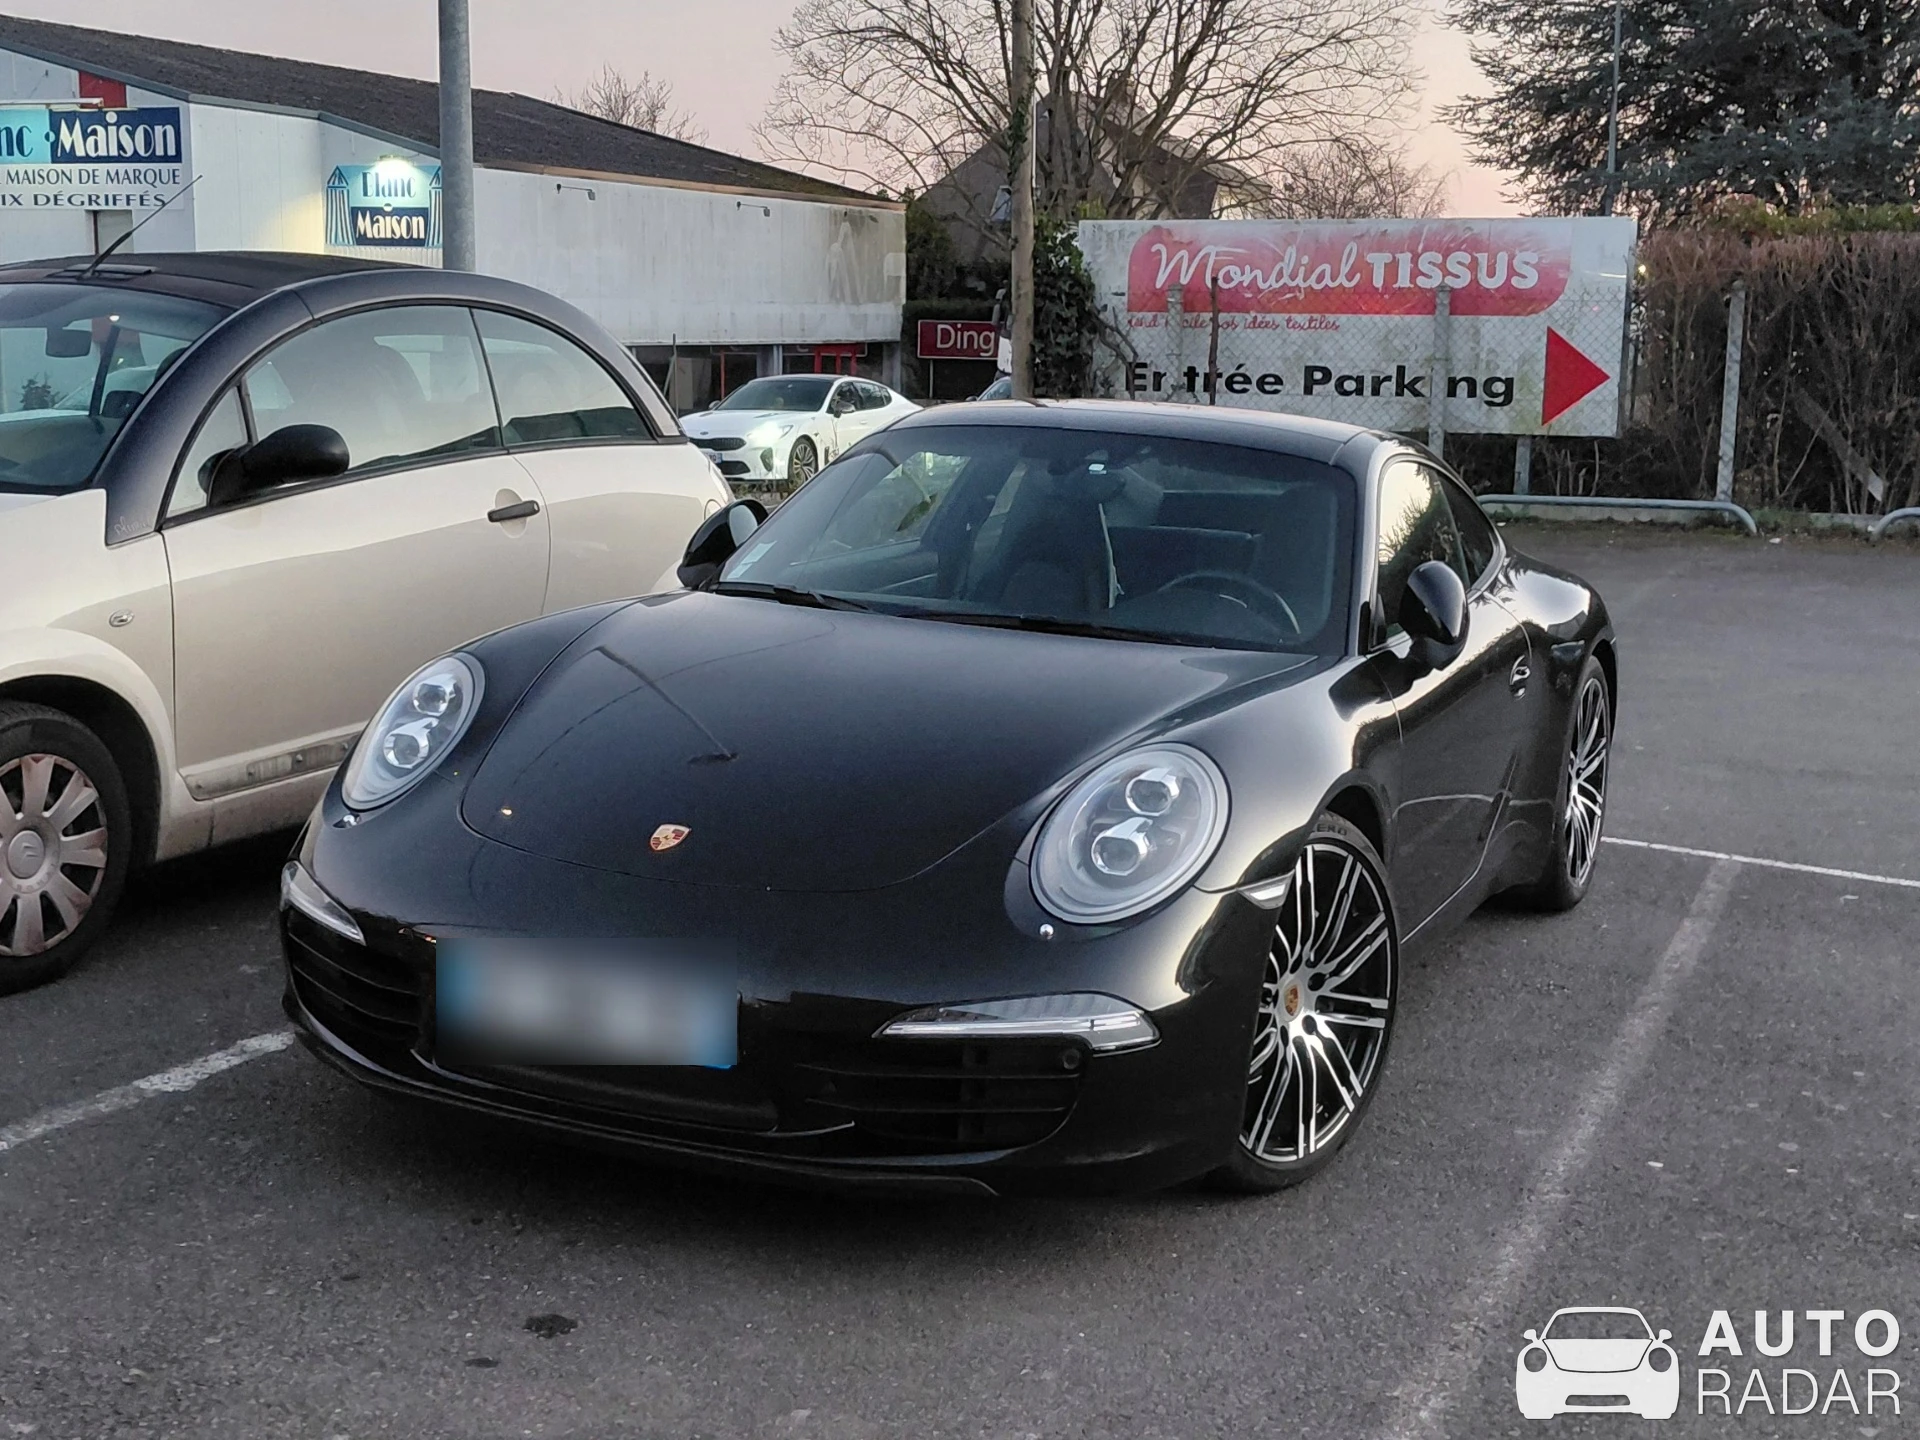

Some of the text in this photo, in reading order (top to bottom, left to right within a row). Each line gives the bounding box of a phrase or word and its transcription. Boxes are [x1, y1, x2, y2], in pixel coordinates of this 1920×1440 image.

[57, 111, 177, 158] Maison
[6, 168, 180, 188] MAISON DE MARQUE
[361, 171, 416, 198] Blanc
[33, 190, 166, 207] DÉGRIFFÉS
[356, 209, 425, 239] Maison
[1151, 241, 1539, 290] Mondial TISSUS
[1285, 314, 1341, 332] textiles
[936, 323, 996, 356] Ding
[1303, 364, 1515, 408] Parkng
